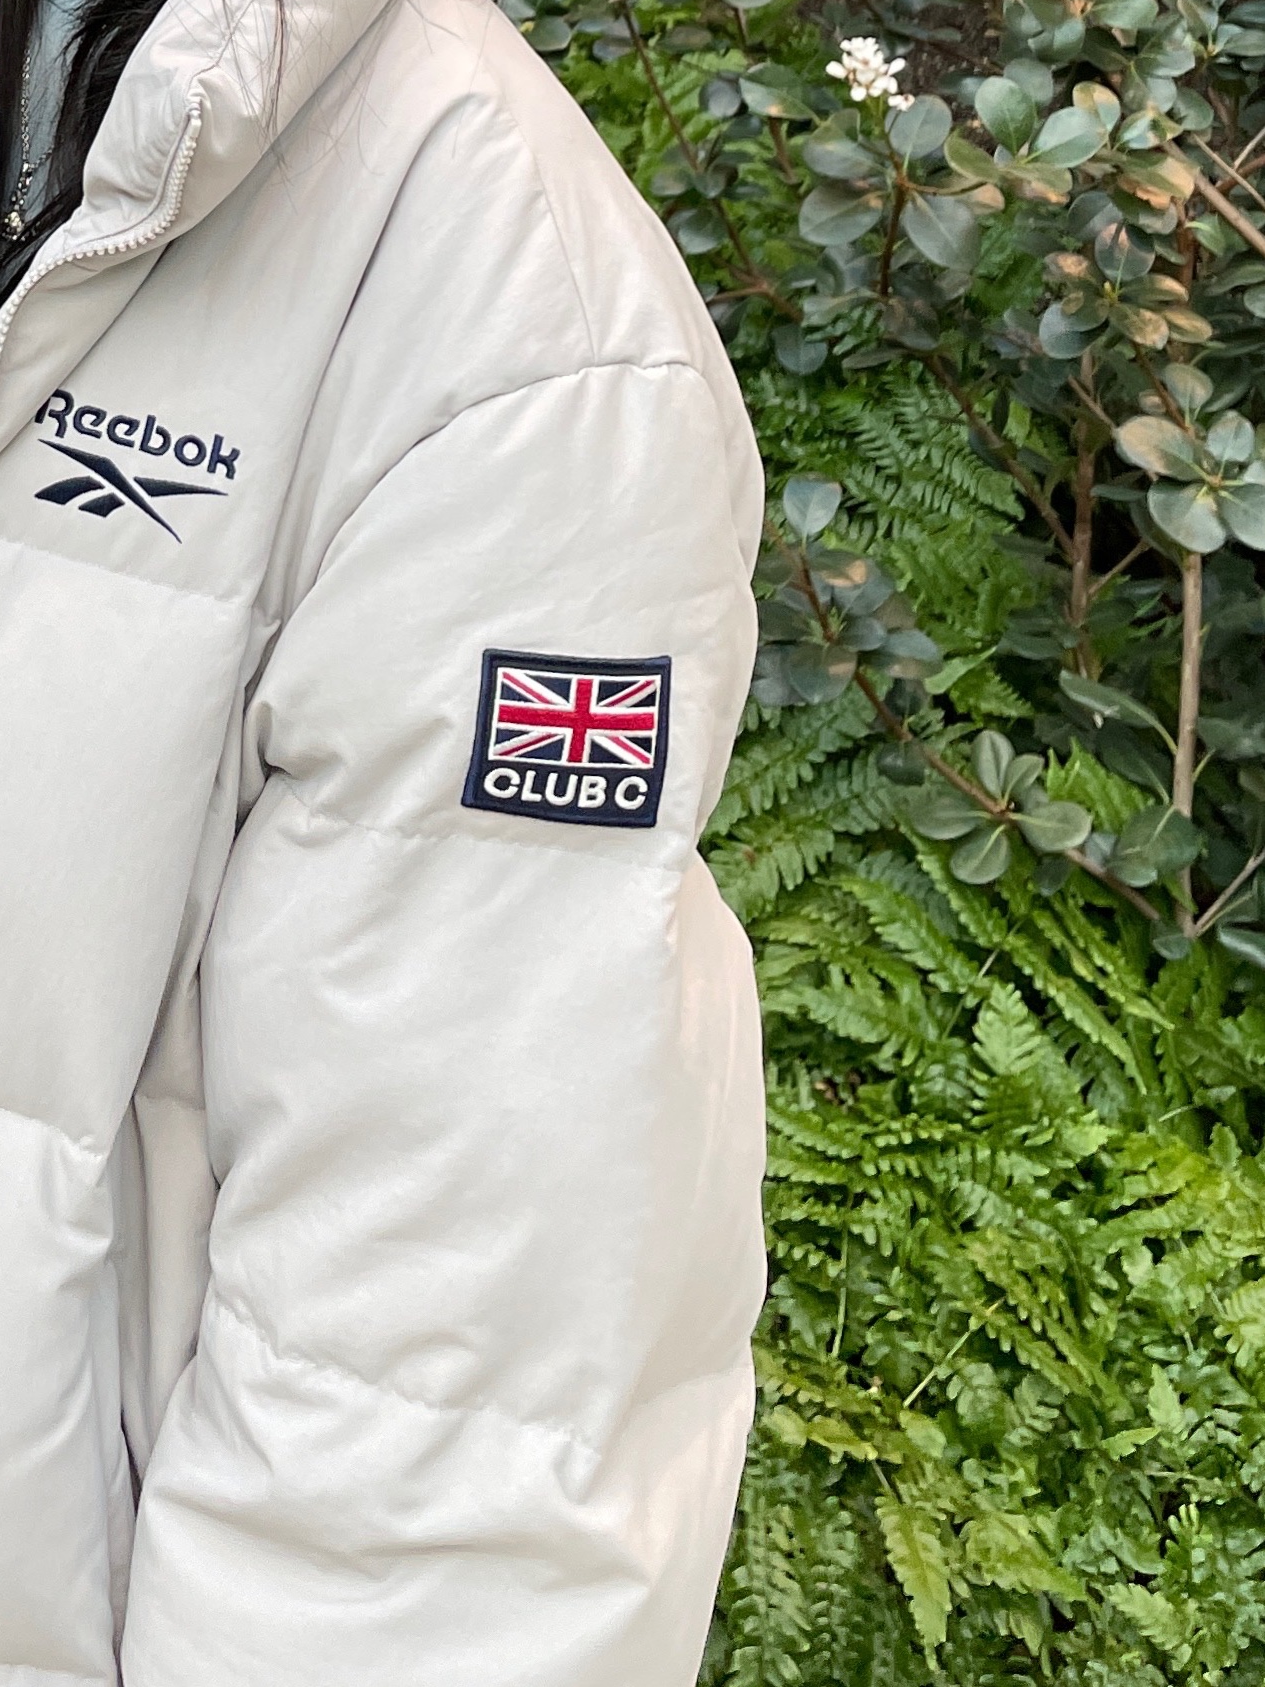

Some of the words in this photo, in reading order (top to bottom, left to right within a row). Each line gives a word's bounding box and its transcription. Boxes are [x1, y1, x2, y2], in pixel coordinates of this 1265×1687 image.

[34, 388, 241, 480] Reebok
[483, 767, 607, 809] CLUB
[614, 776, 649, 811] C
